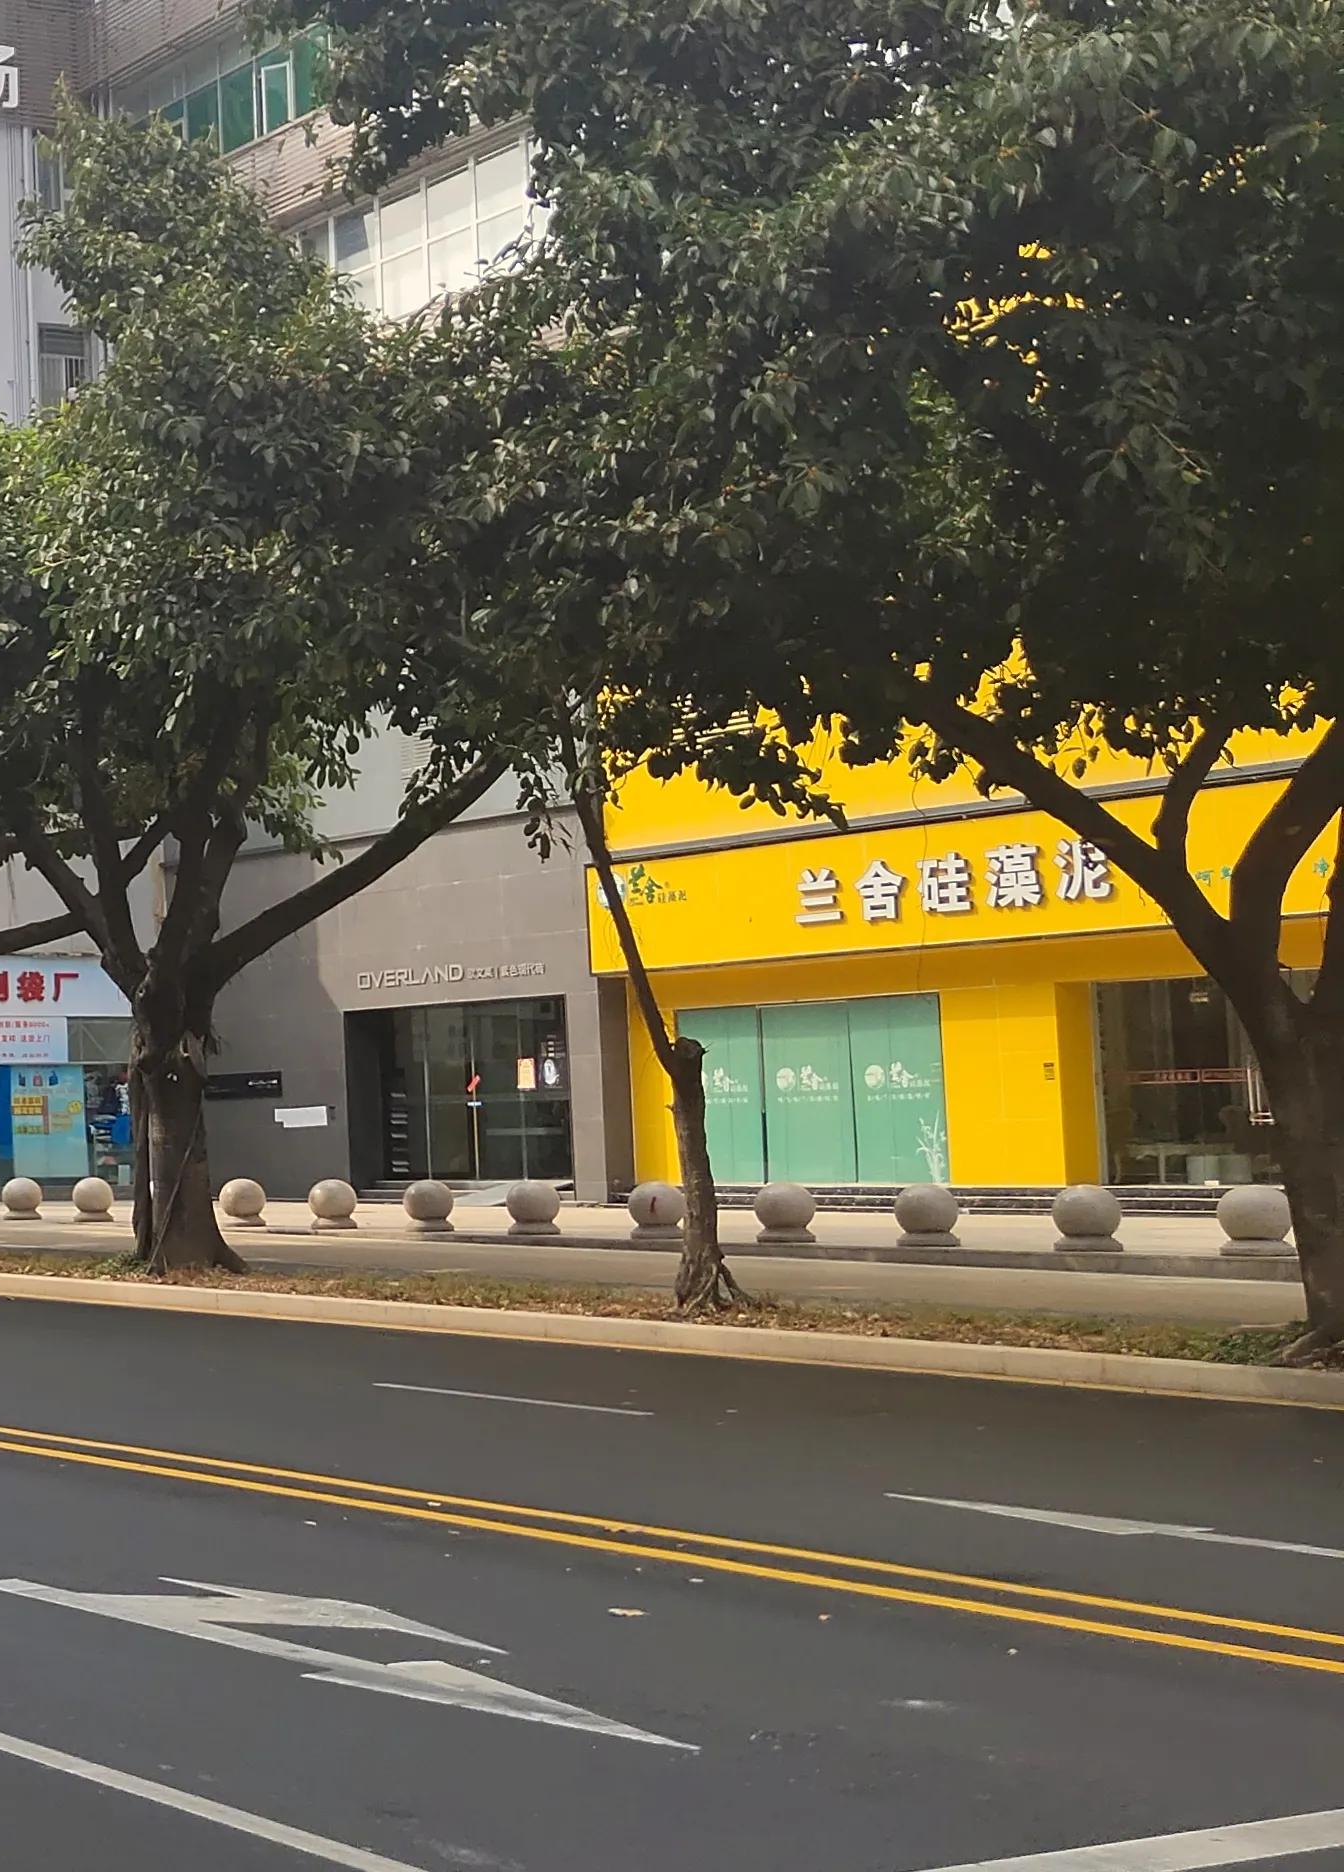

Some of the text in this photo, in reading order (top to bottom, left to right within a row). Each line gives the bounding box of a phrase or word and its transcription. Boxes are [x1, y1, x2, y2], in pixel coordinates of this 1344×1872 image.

[795, 839, 1112, 924] 兰舍硅藻泥
[357, 964, 464, 989] OVERLAND
